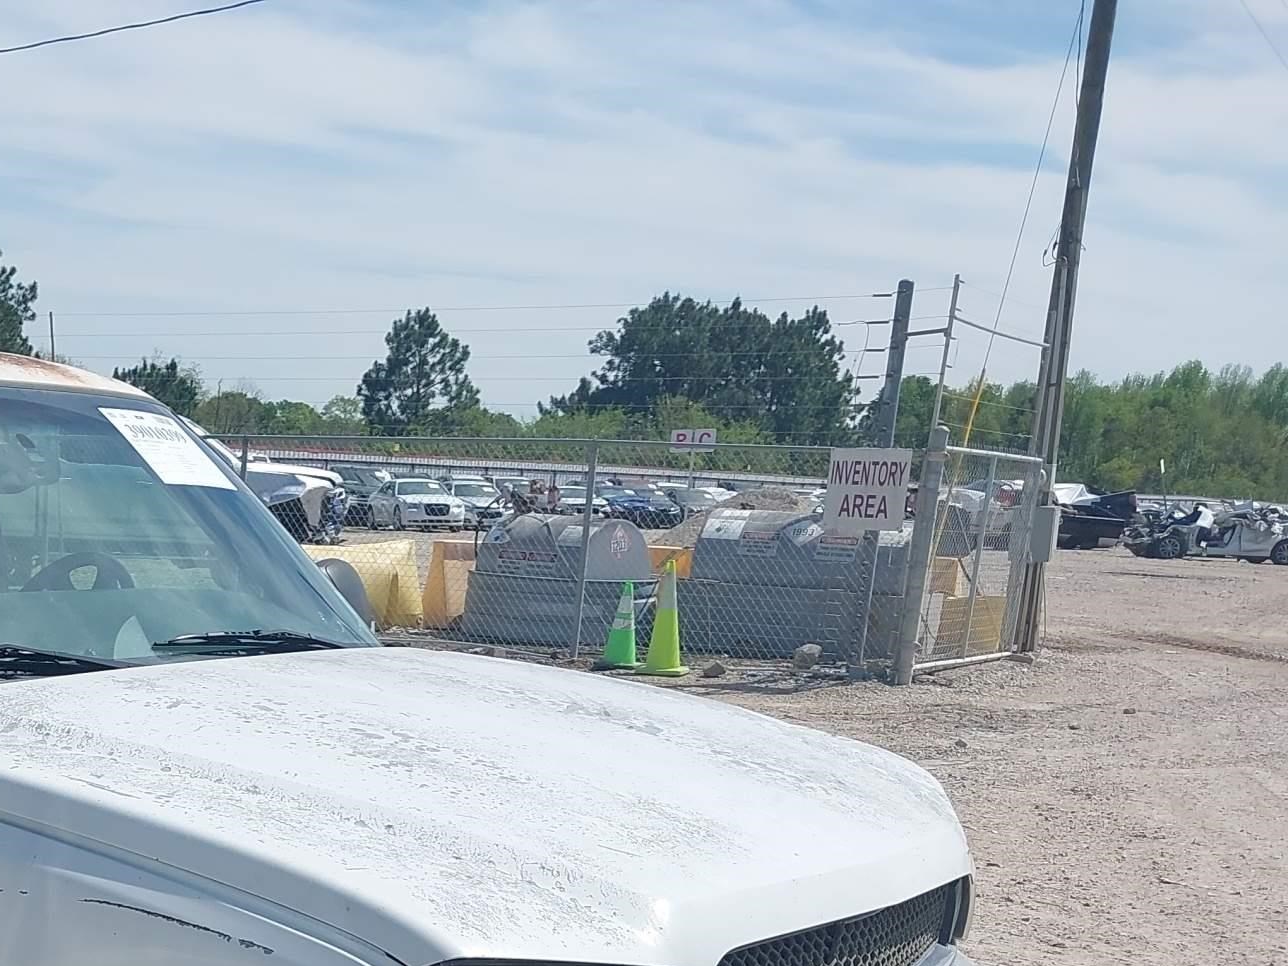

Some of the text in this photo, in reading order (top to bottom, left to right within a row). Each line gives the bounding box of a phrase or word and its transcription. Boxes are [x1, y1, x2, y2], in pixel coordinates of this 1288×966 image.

[830, 460, 908, 487] INVENTORY
[837, 493, 888, 519] AREA
[792, 528, 816, 537] 1993
